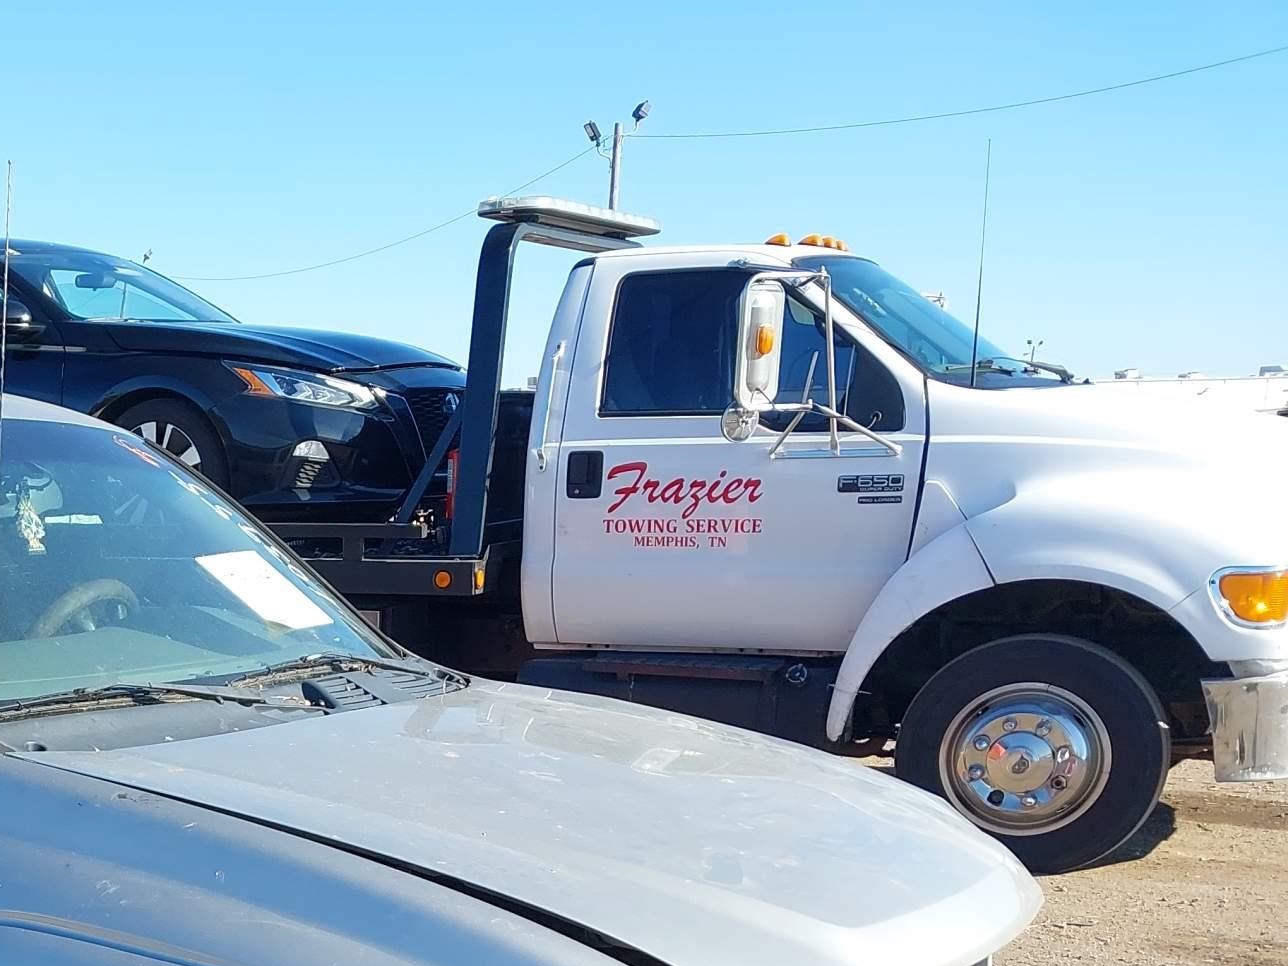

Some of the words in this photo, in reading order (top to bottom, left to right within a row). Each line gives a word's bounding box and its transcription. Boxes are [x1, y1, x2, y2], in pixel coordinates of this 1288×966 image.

[607, 461, 763, 520] Frazier
[603, 518, 677, 534] TOWING
[685, 518, 762, 534] SERVICE
[634, 536, 700, 549] MEMPHIS,
[708, 536, 727, 548] TN
